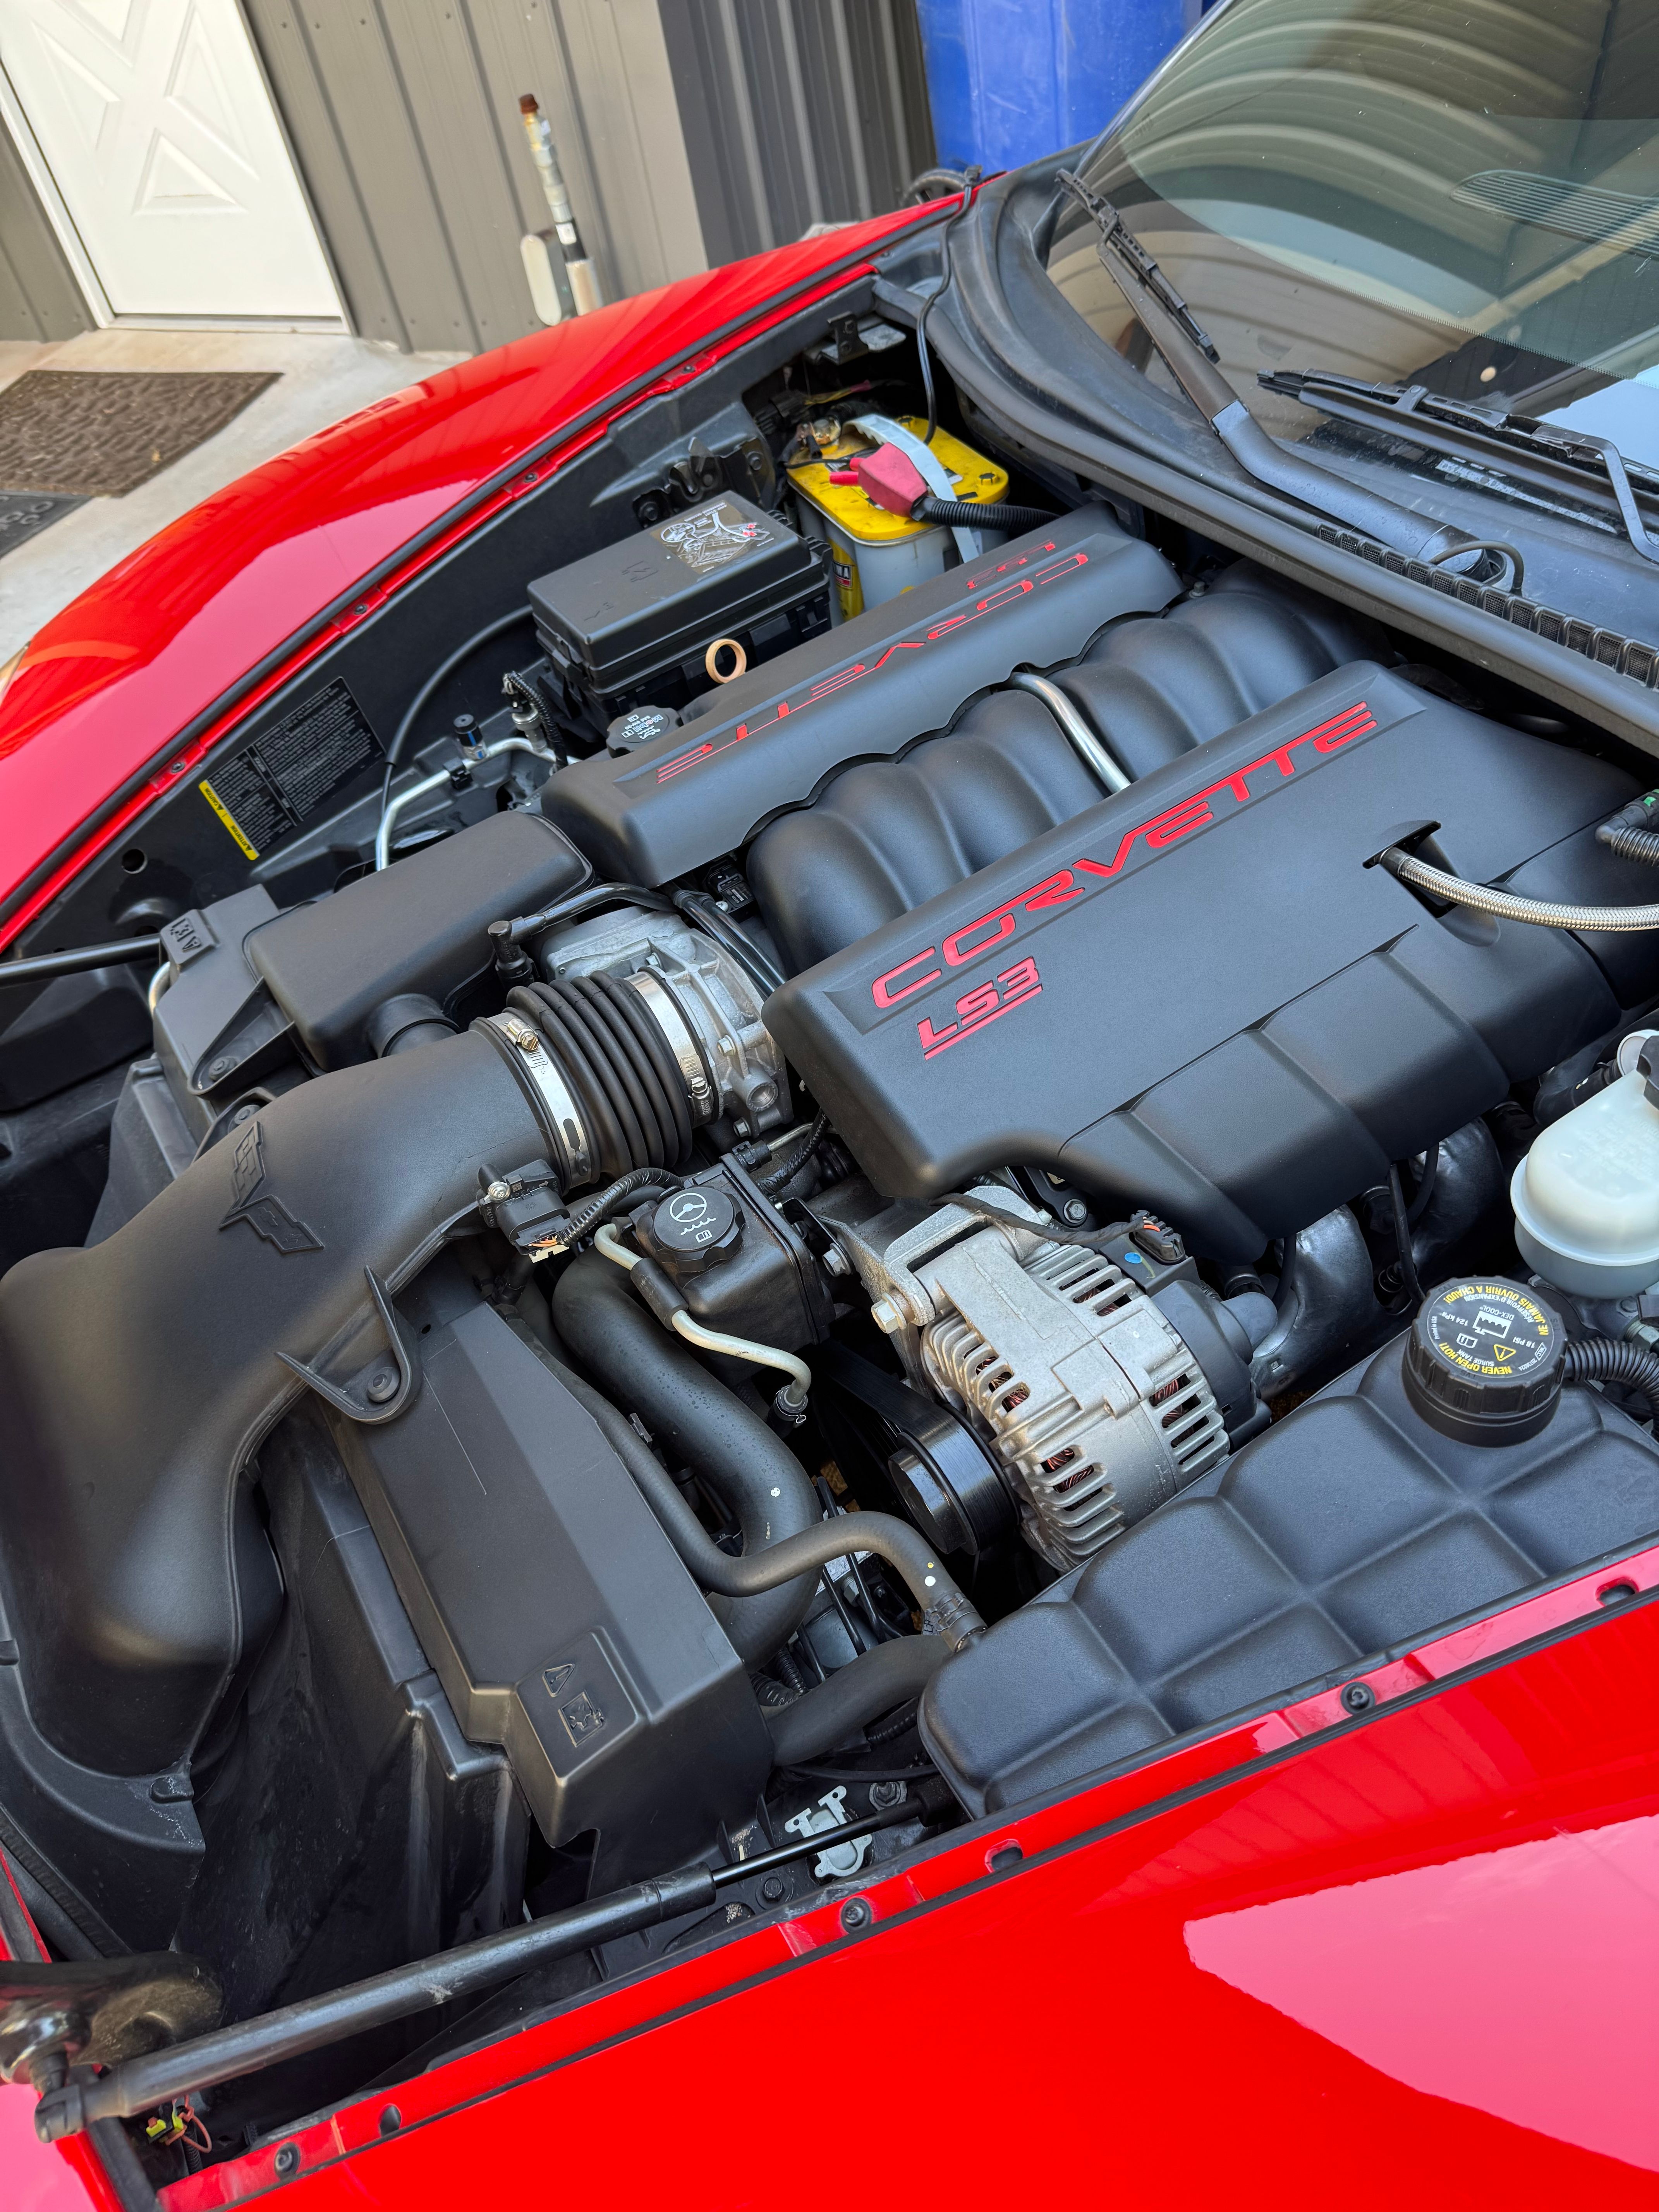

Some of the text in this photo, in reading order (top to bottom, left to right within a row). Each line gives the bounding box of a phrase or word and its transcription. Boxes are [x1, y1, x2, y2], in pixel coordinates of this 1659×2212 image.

[656, 553, 1089, 785] CORVETTE
[632, 714, 664, 732] Mobil
[204, 788, 218, 806] CAUTION
[230, 825, 247, 846] ATTENTION
[871, 701, 1378, 1008] CORVETTE
[917, 955, 1042, 1050] LS3
[1443, 1286, 1475, 1304] CHAUD!
[1485, 1286, 1519, 1301] OUVRIR
[1442, 1312, 1468, 1326] 124 kPa
[1518, 1298, 1546, 1324] JAMAIS
[1538, 1324, 1549, 1335] NE
[1513, 1336, 1526, 1345] PSI
[1439, 1342, 1512, 1375] NEVER OPEN HOT!
[1456, 1349, 1494, 1367] SURGE TANK
